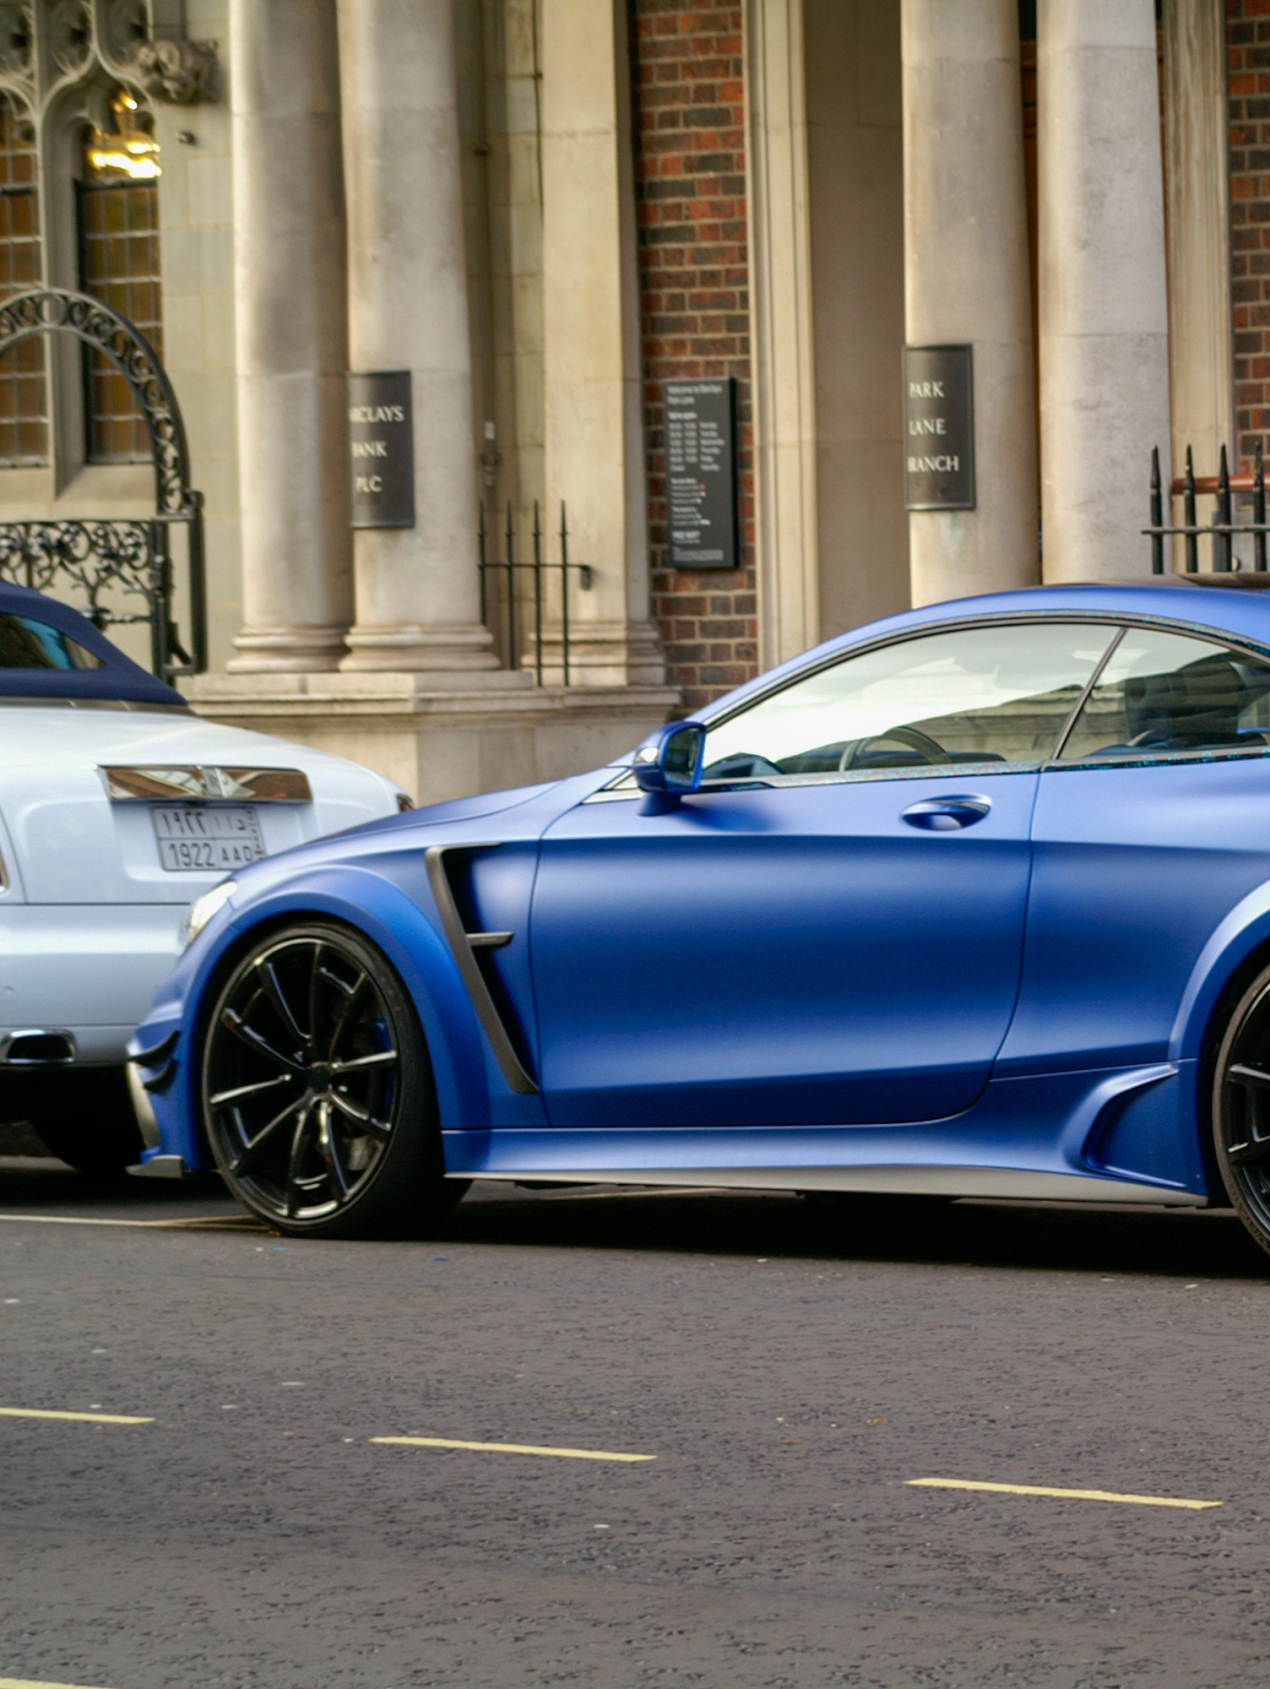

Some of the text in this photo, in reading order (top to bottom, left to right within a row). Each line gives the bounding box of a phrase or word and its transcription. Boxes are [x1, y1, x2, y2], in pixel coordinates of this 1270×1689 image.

[908, 381, 945, 398] PARK
[908, 418, 947, 436] LANE
[169, 842, 216, 867] 1922
